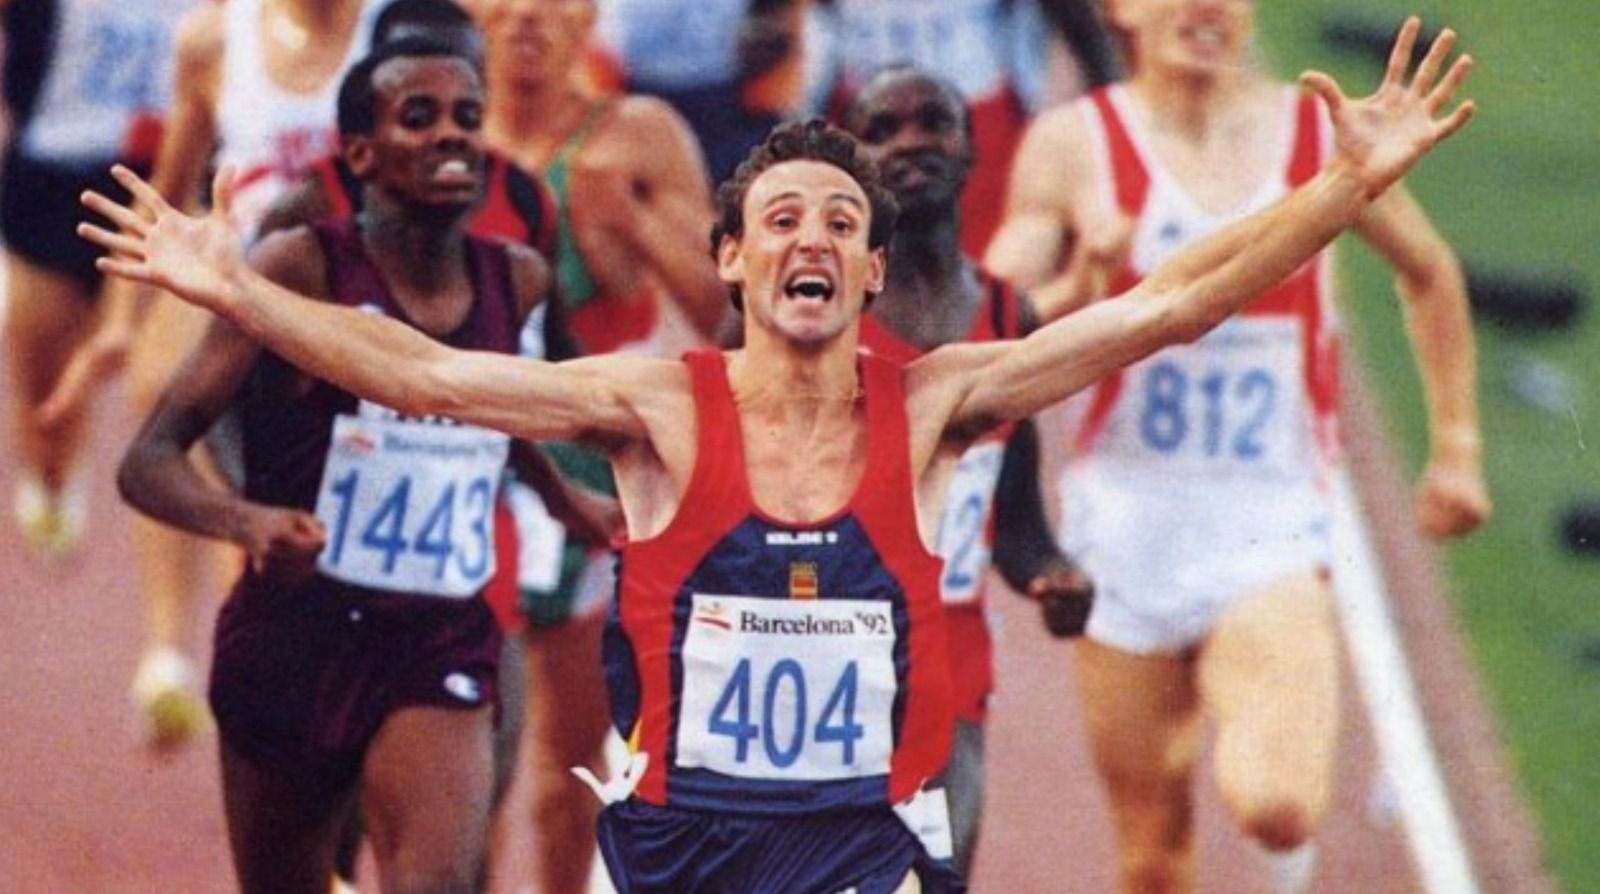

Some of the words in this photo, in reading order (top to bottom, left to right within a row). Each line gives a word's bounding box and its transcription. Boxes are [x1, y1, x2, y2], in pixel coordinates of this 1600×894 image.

[1140, 359, 1278, 461] 812
[330, 467, 491, 582] 1443
[740, 610, 855, 635] Barcelona
[856, 611, 889, 637] '92
[708, 656, 864, 769] 404
